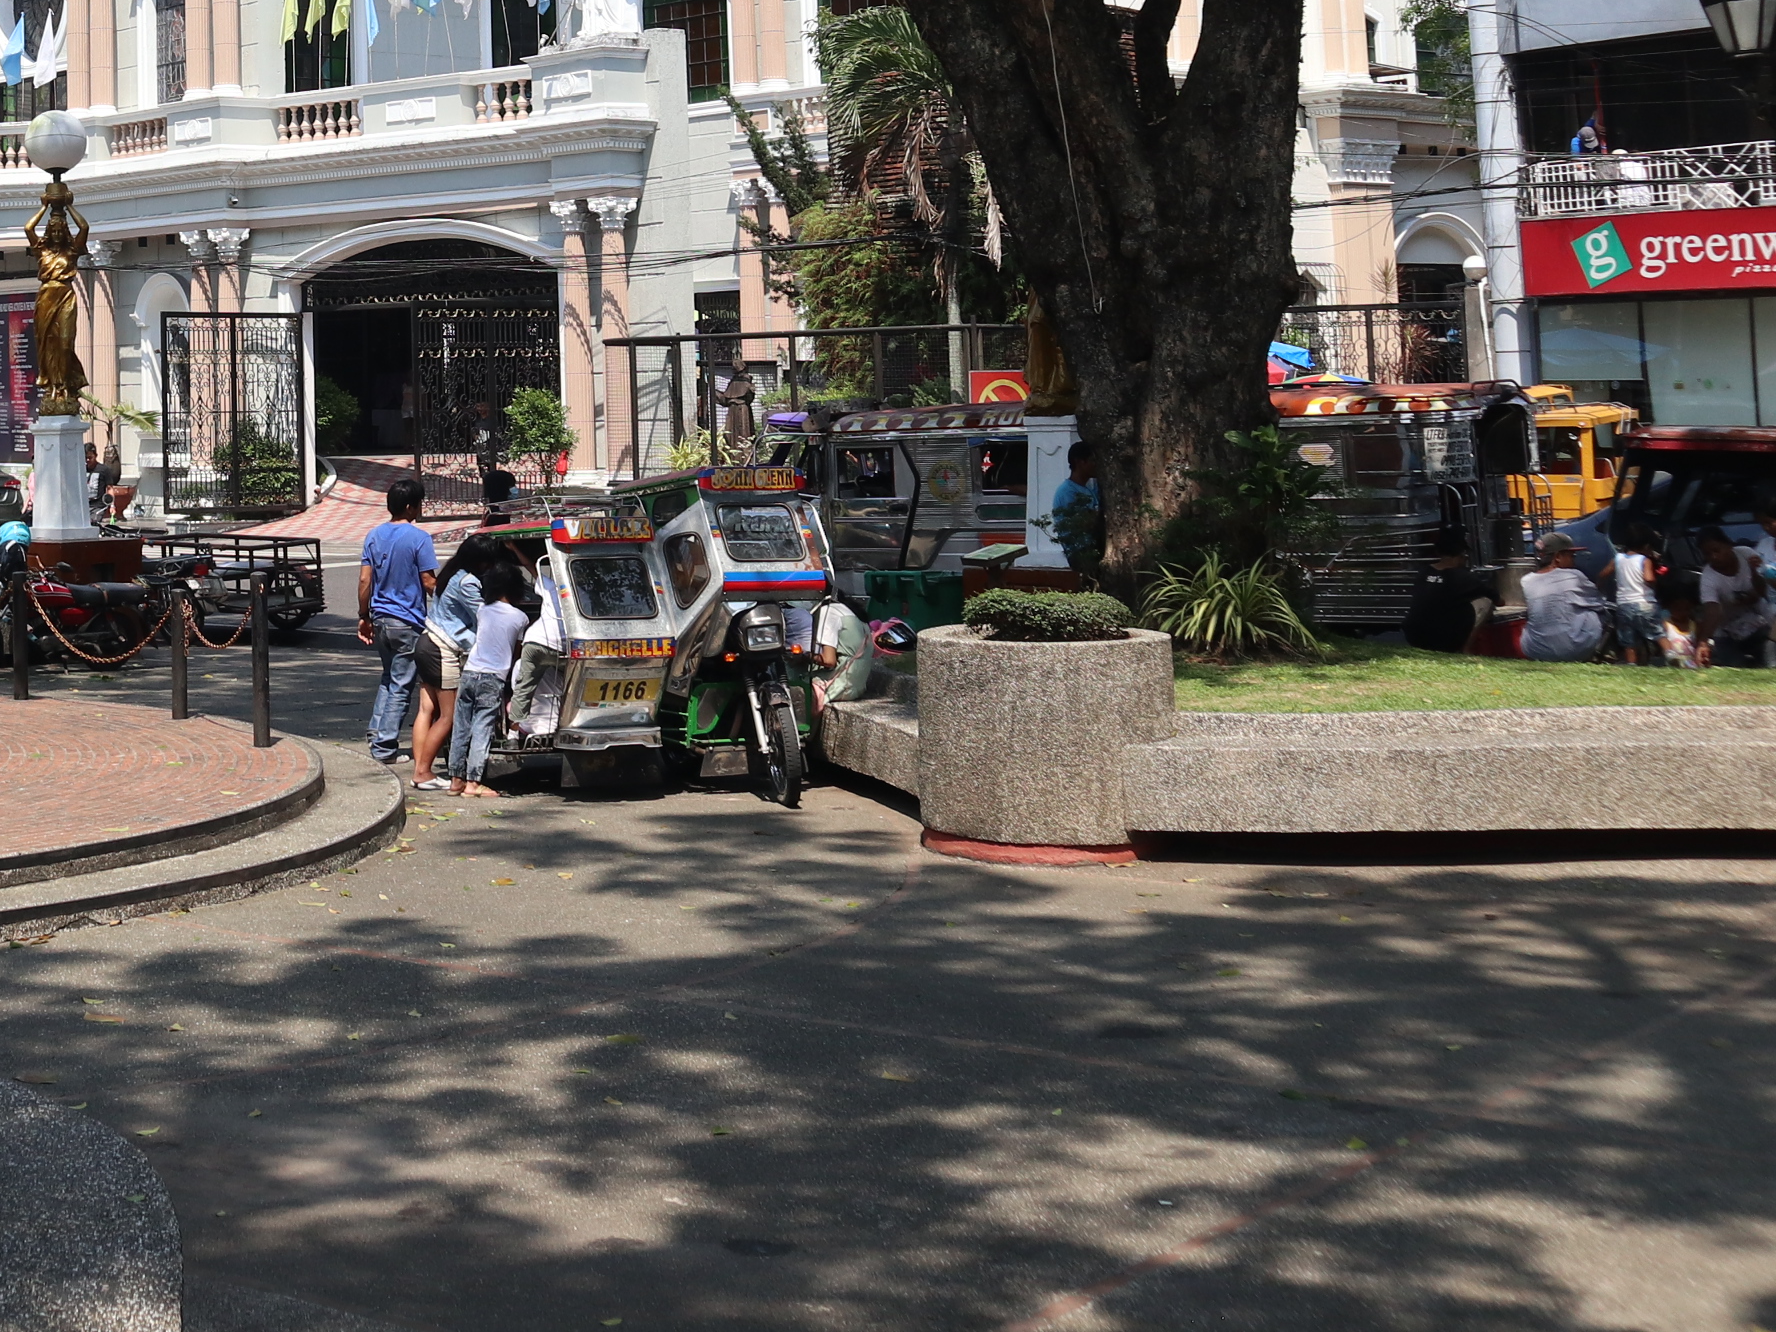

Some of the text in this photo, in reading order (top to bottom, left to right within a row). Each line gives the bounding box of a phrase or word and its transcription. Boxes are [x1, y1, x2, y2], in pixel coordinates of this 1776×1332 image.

[1585, 229, 1618, 280] g
[712, 468, 795, 489] JOHN GLENN
[599, 680, 647, 701] 1166
